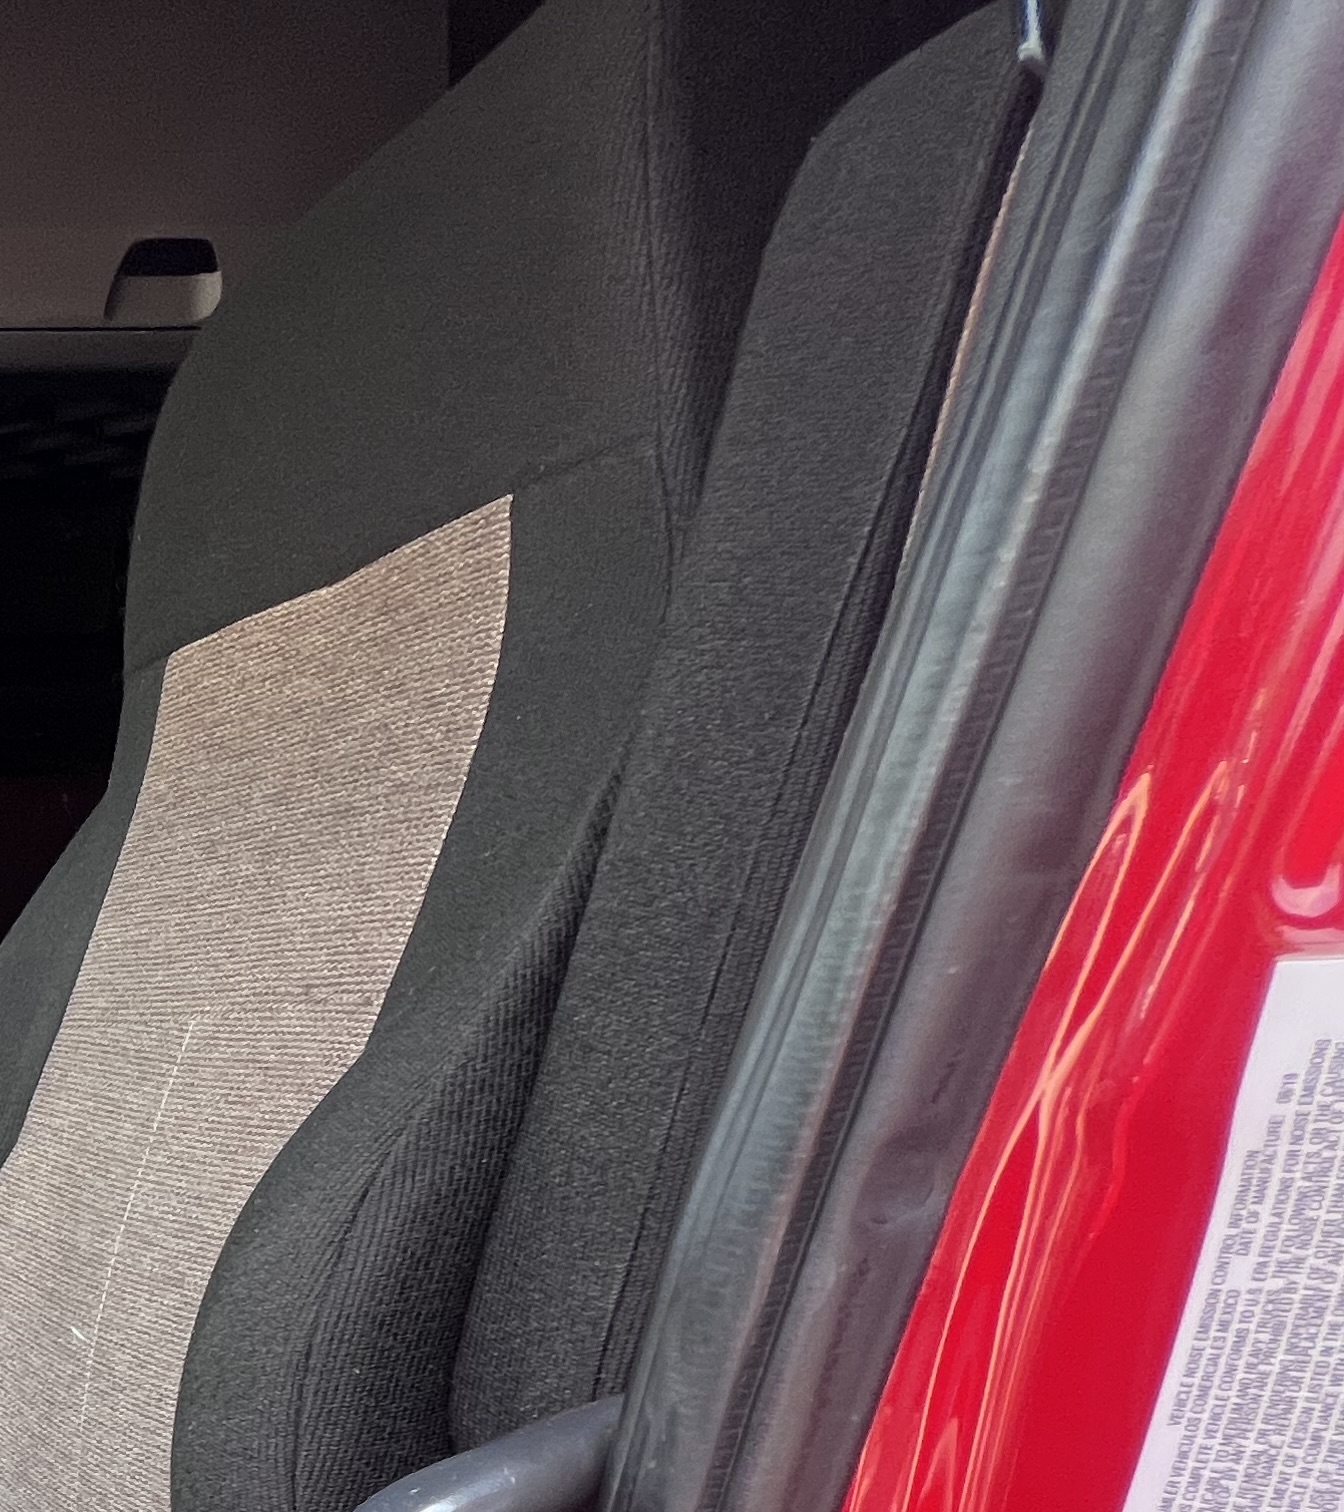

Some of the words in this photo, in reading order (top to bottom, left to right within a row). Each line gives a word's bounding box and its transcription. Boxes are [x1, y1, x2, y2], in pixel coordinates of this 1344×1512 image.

[1289, 1111, 1310, 1145] NOISE
[1282, 1149, 1300, 1173] FOR
[1244, 1210, 1259, 1224] OF
[1258, 1177, 1294, 1257] REGULATIONS
[1234, 1229, 1256, 1256] DATE
[1167, 1382, 1193, 1426] VEHICLE
[1182, 1345, 1205, 1377] NOISE
[1194, 1288, 1221, 1341] EMISSION
[1211, 1233, 1238, 1285] CONTROL
[1228, 1149, 1260, 1228] INFORMATION
[1250, 1260, 1269, 1282] EPA
[1215, 1289, 1240, 1332] MEXICO
[1238, 1309, 1254, 1323] TO
[1218, 1327, 1249, 1391] CONFORMS
[1203, 1395, 1229, 1439] VEHICLE
[1287, 1406, 1315, 1449] DESIGN
[1182, 1445, 1212, 1501] COMPLETE
[1282, 1453, 1297, 1468] OF
